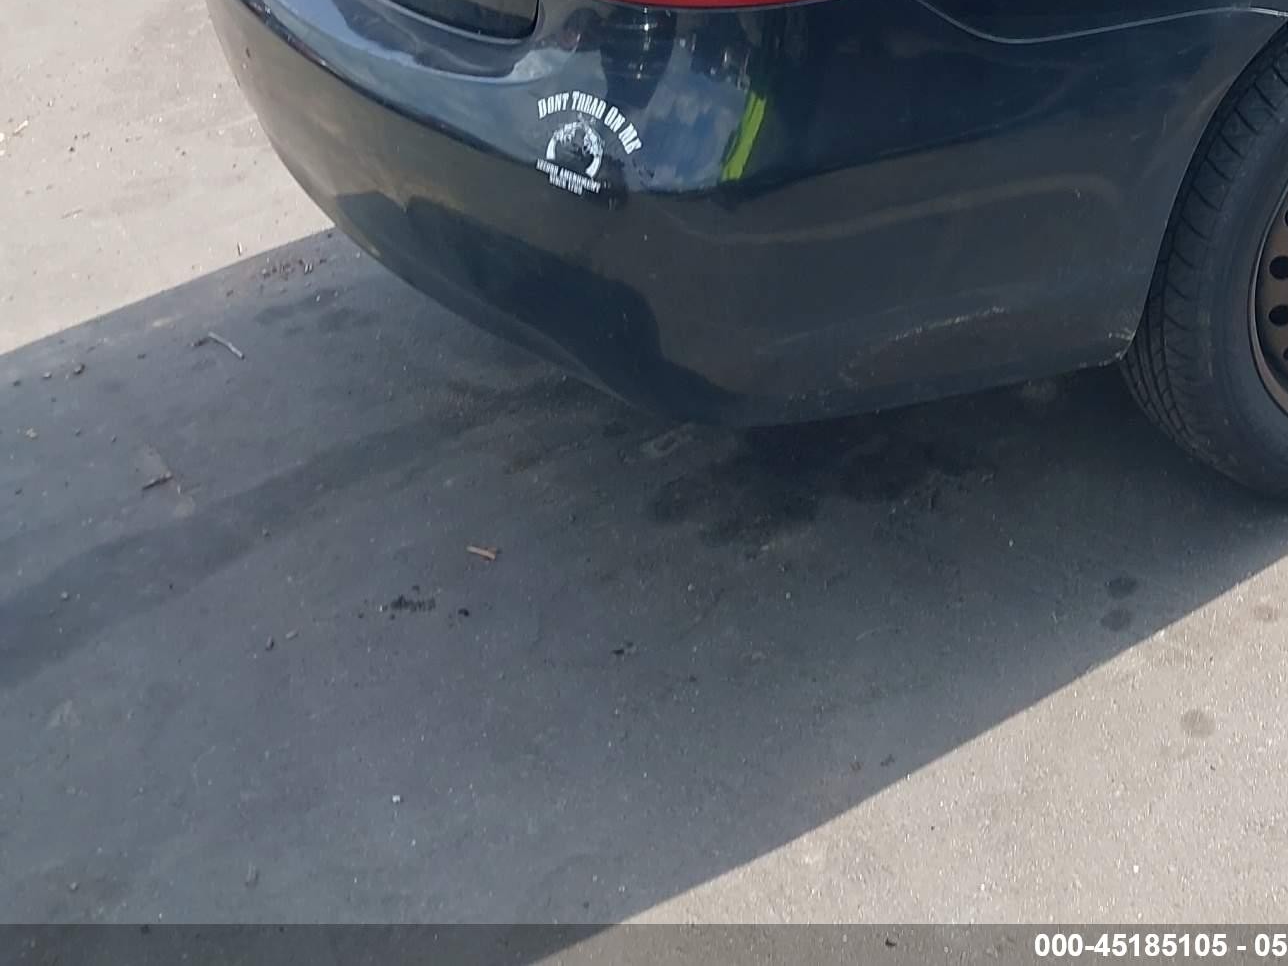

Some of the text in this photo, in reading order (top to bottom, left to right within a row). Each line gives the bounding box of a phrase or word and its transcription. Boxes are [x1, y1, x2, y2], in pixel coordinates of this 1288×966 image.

[537, 90, 642, 155] DONT TREAD ON ME
